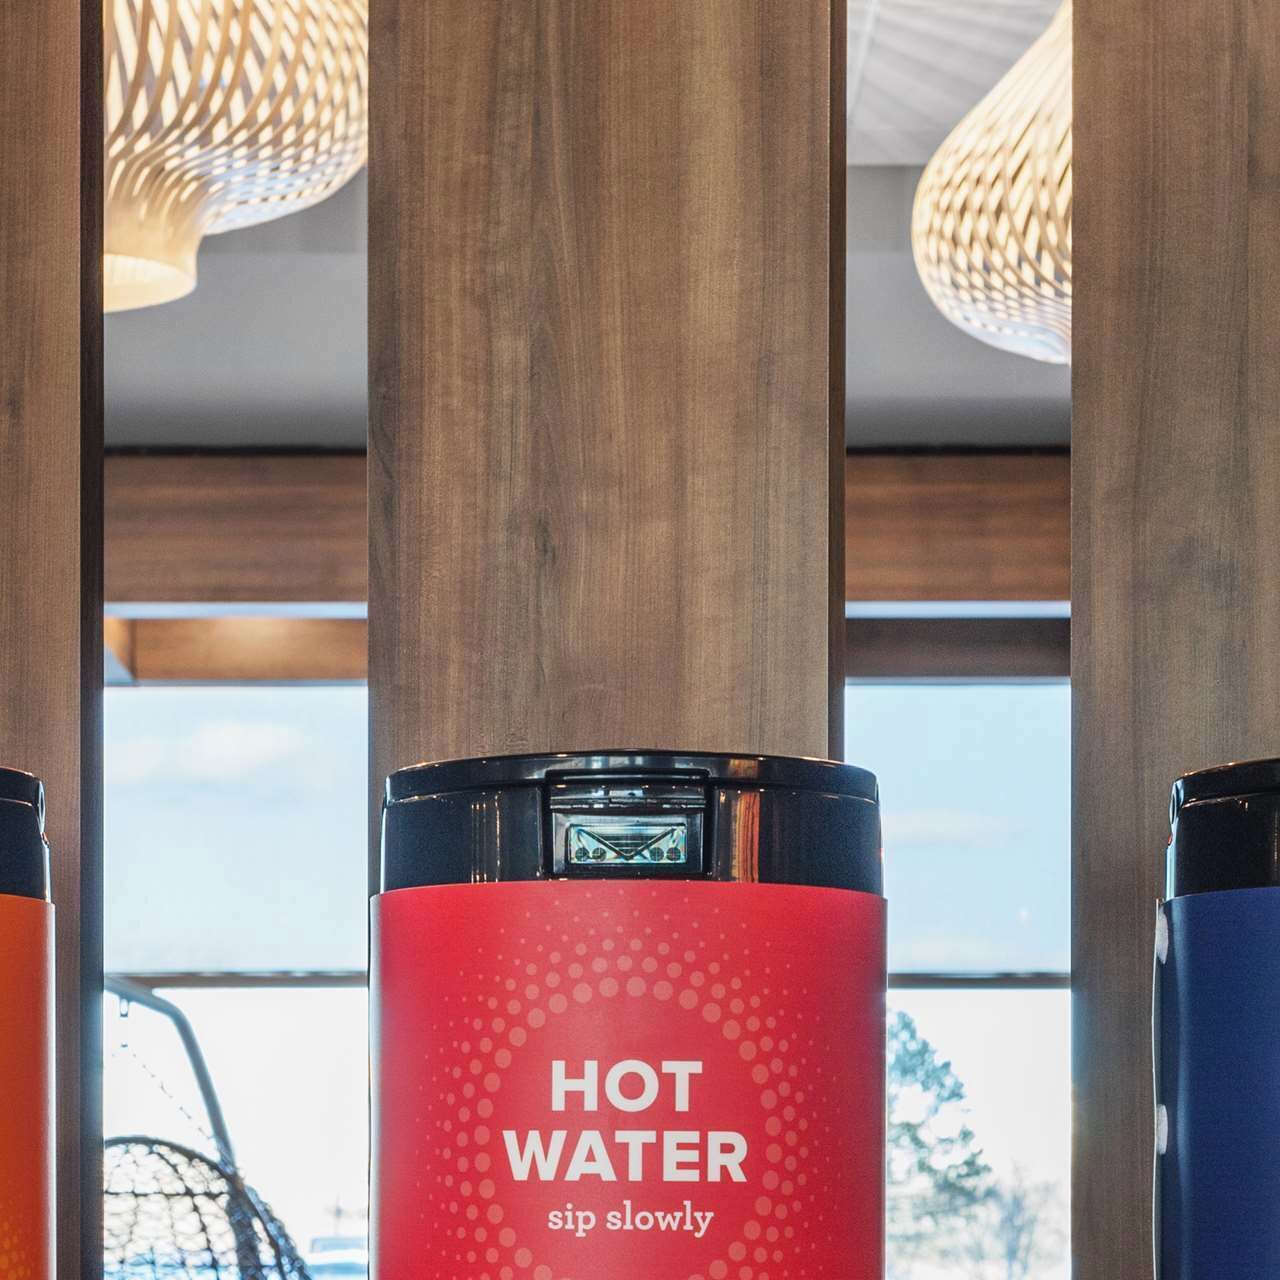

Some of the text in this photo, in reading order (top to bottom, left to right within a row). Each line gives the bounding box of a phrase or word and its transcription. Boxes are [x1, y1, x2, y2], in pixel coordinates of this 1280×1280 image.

[551, 1058, 703, 1113] HOT
[502, 1129, 749, 1183] WATER
[547, 1199, 715, 1239] sip slowly
